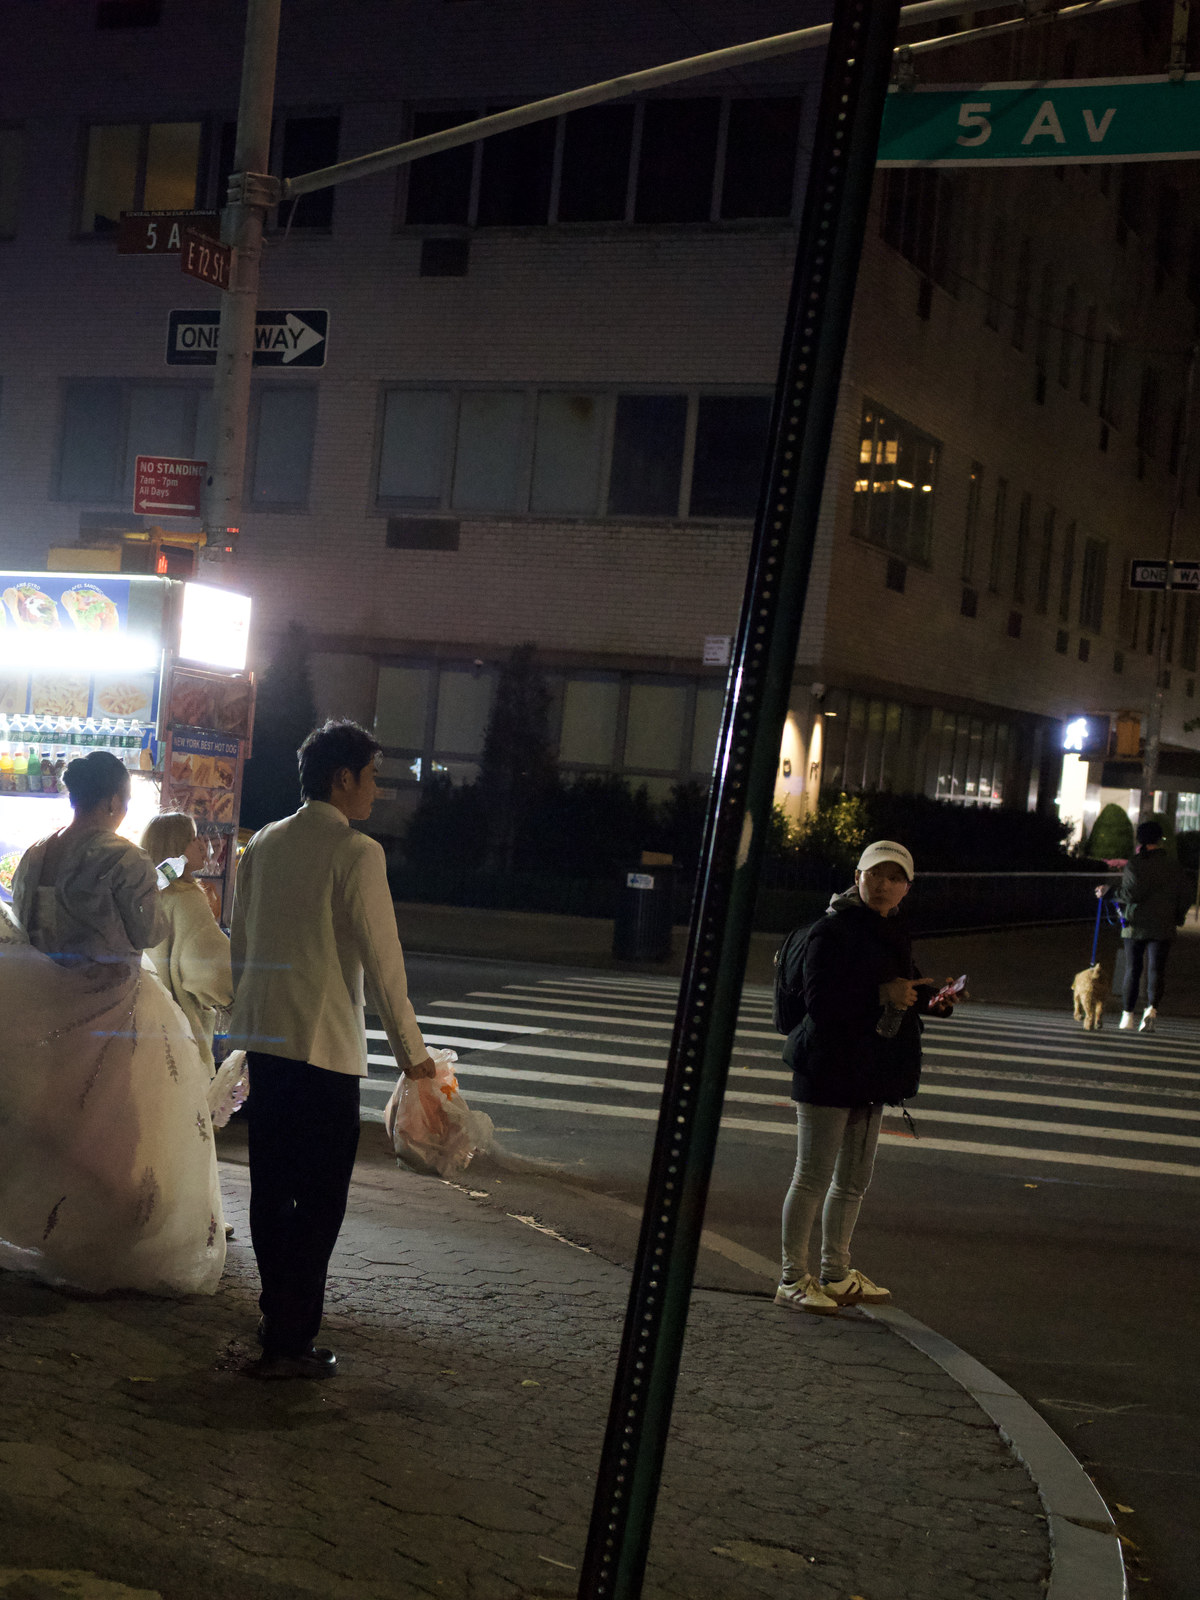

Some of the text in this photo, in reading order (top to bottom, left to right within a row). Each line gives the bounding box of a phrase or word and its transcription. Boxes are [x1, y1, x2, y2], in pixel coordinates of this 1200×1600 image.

[956, 101, 1117, 146] 5 Av
[146, 222, 158, 250] 5
[167, 222, 181, 249] A
[188, 242, 225, 283] E 72 St
[255, 328, 305, 349] WAY
[140, 461, 154, 473] NO
[140, 475, 155, 485] 7am
[162, 476, 178, 487] 7pm
[139, 486, 169, 498] All Days
[1181, 571, 1200, 582] WA
[186, 738, 200, 748] YORK
[201, 740, 213, 750] BEST
[214, 742, 225, 751] HOT
[226, 743, 237, 754] DOG
